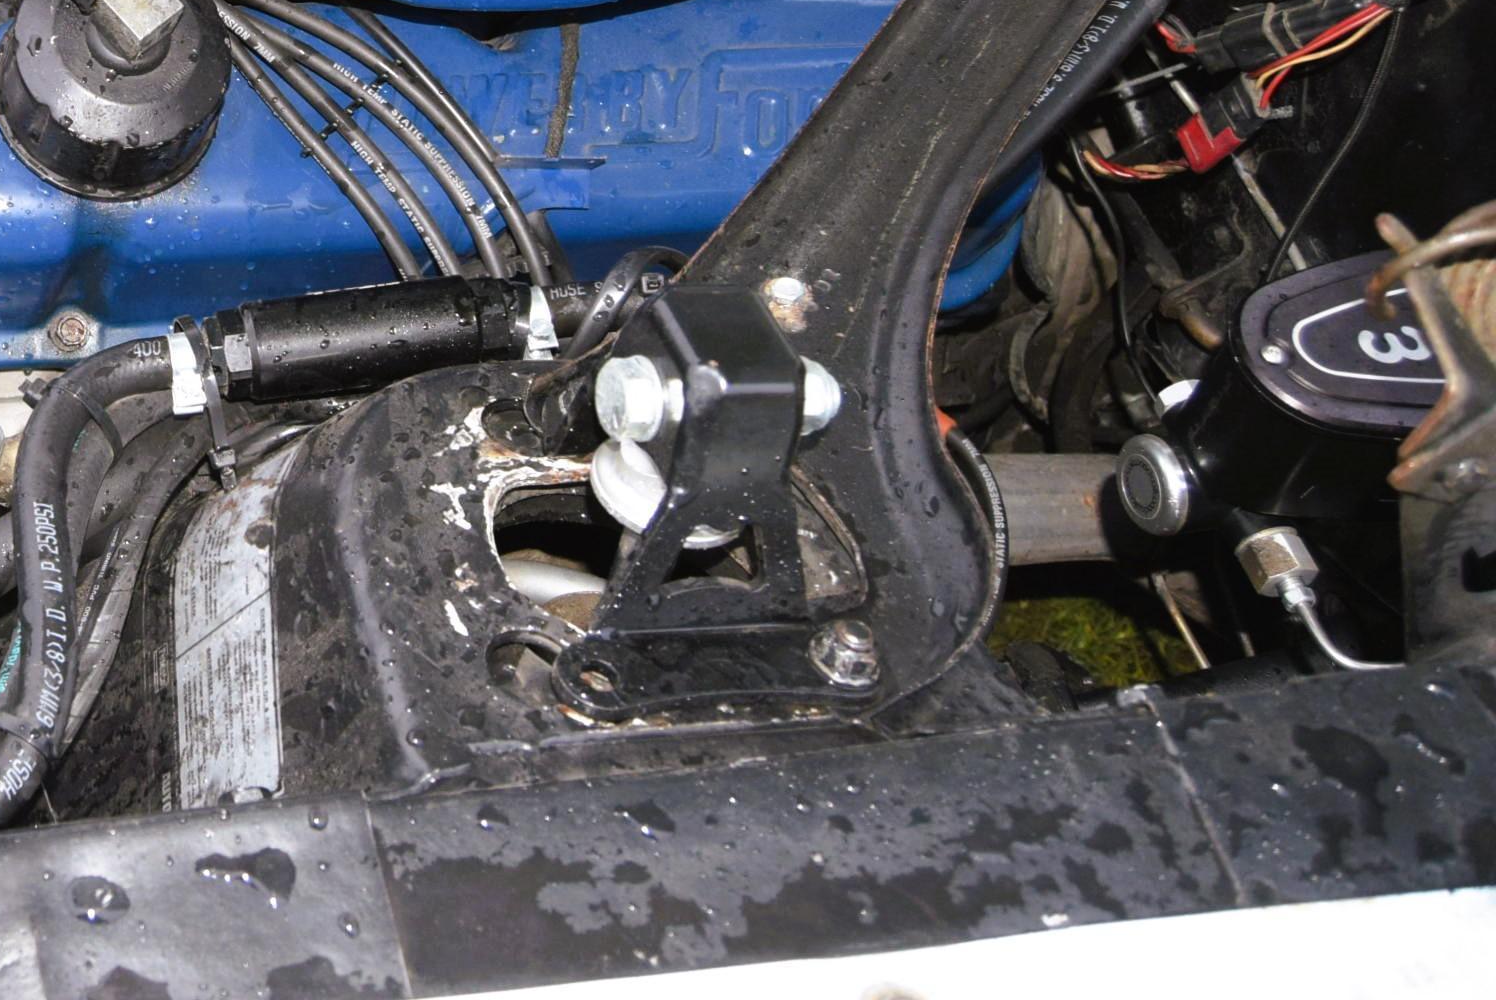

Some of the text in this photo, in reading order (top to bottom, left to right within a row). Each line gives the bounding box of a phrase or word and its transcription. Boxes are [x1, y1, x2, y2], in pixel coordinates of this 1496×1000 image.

[391, 107, 425, 142] STATIC
[133, 339, 162, 358] 400
[1358, 325, 1432, 364] 3
[978, 463, 1006, 529] SUPPRESSION
[32, 501, 65, 593] W.P.250PSI
[993, 531, 1006, 569] STATIC
